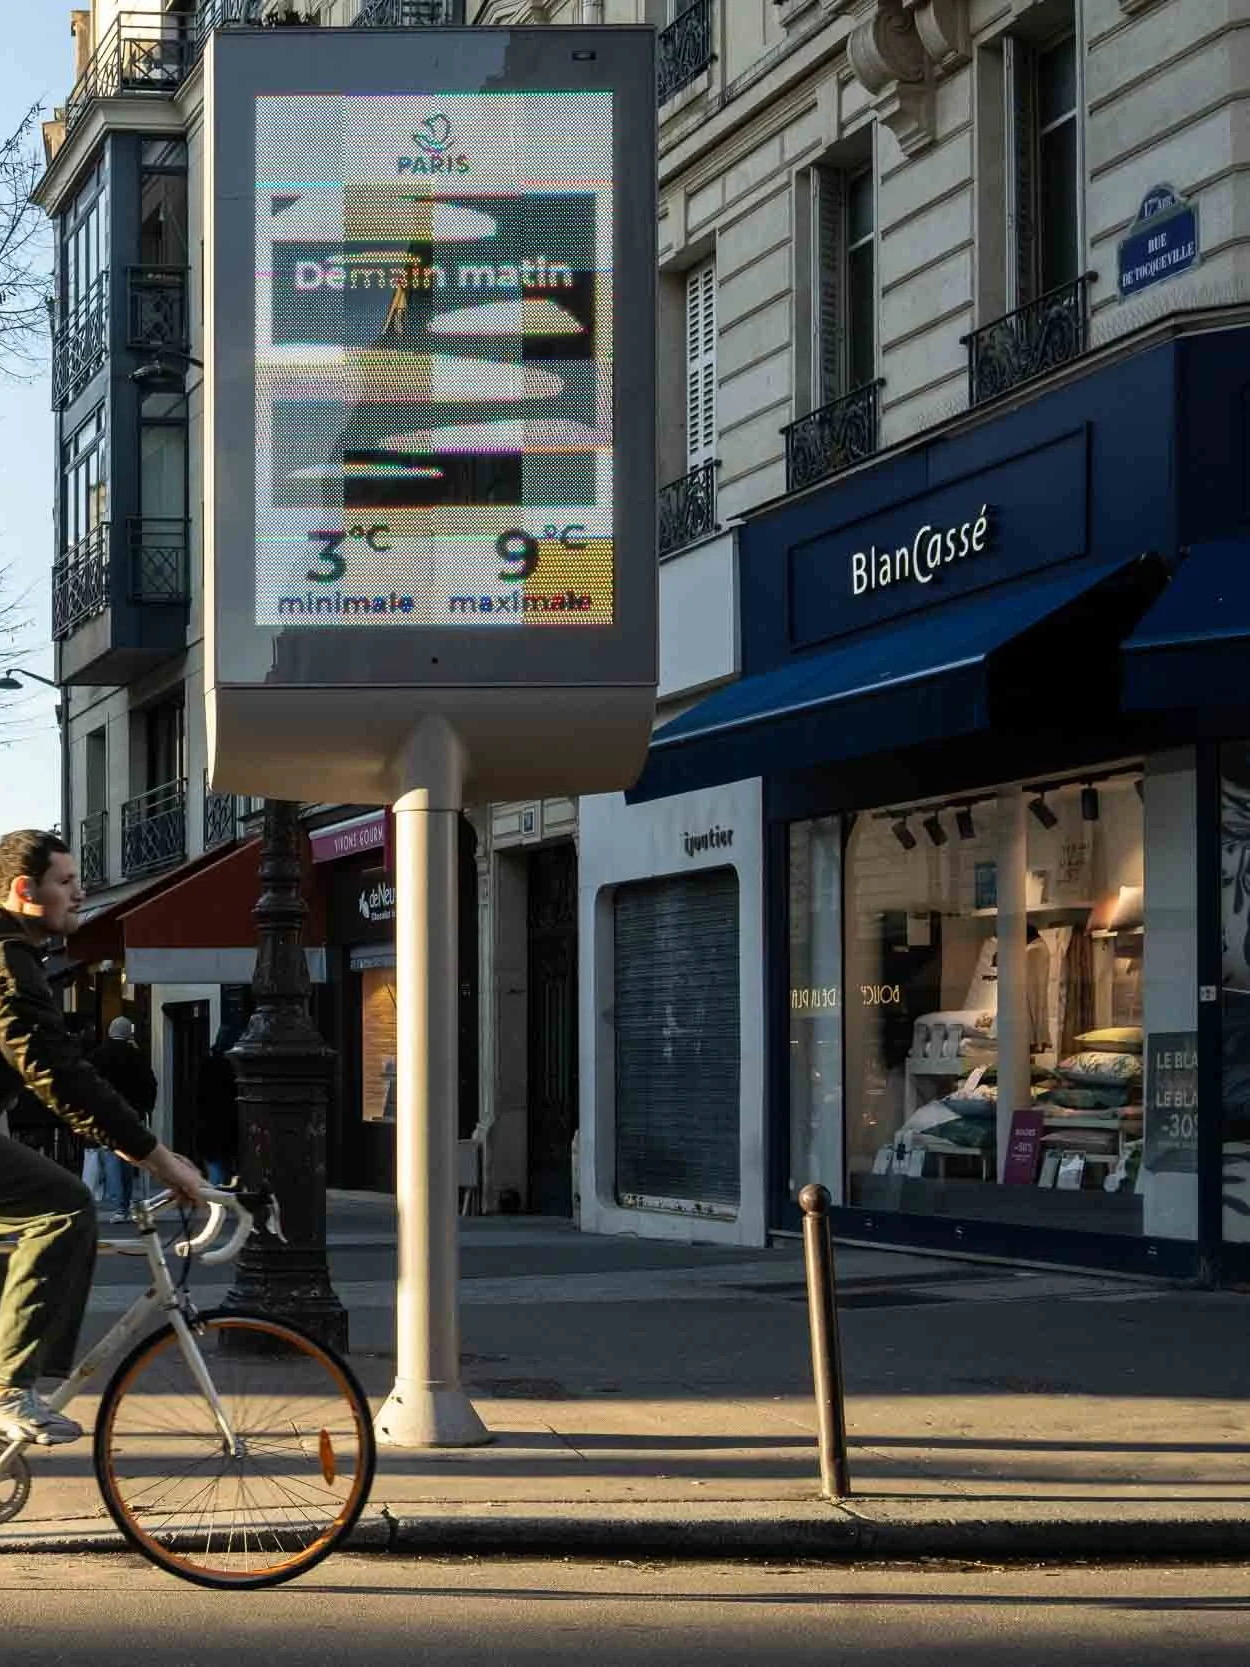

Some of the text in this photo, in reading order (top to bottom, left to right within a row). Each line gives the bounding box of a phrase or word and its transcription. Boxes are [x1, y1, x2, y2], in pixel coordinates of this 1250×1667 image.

[398, 155, 469, 174] PARIS
[1148, 233, 1167, 253] RUE
[295, 256, 573, 290] Demain matin
[1122, 241, 1195, 288] DE TOCQUEVILLE
[278, 590, 592, 614] minimale maximale
[1157, 1053, 1172, 1069] LE
[1156, 1092, 1172, 1108] LE
